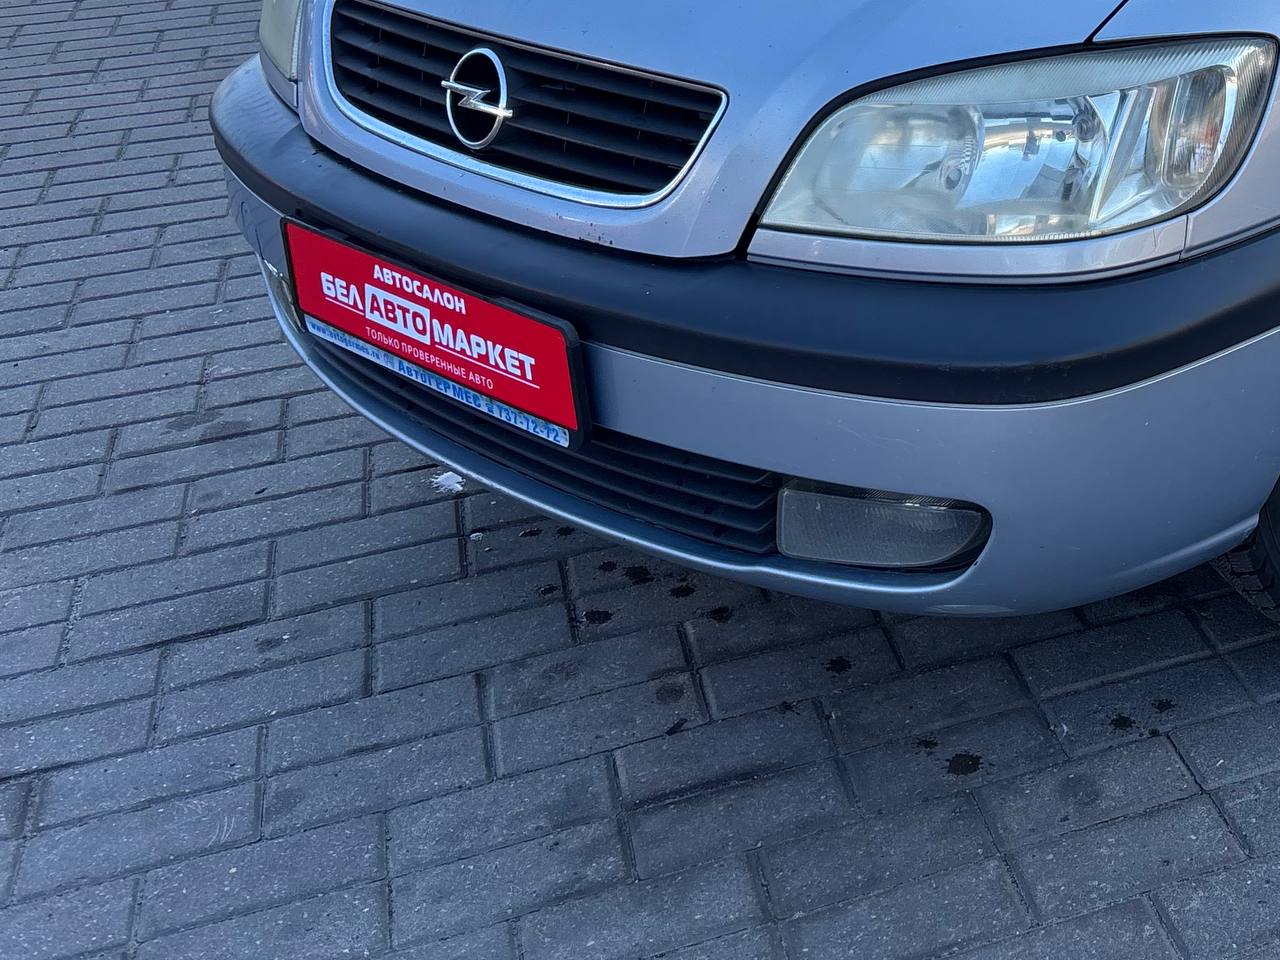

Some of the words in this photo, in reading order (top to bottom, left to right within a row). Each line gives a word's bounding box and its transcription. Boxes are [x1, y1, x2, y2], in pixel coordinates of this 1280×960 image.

[372, 263, 467, 315] АВТОСАЛОН
[310, 320, 381, 360] www.avtogermes.ru
[365, 326, 401, 349] ТОЛЬКО
[401, 342, 467, 379] ПРОВЕРЕННЫЕ
[468, 371, 495, 390] АВТО
[496, 401, 561, 444] 737-72-72
